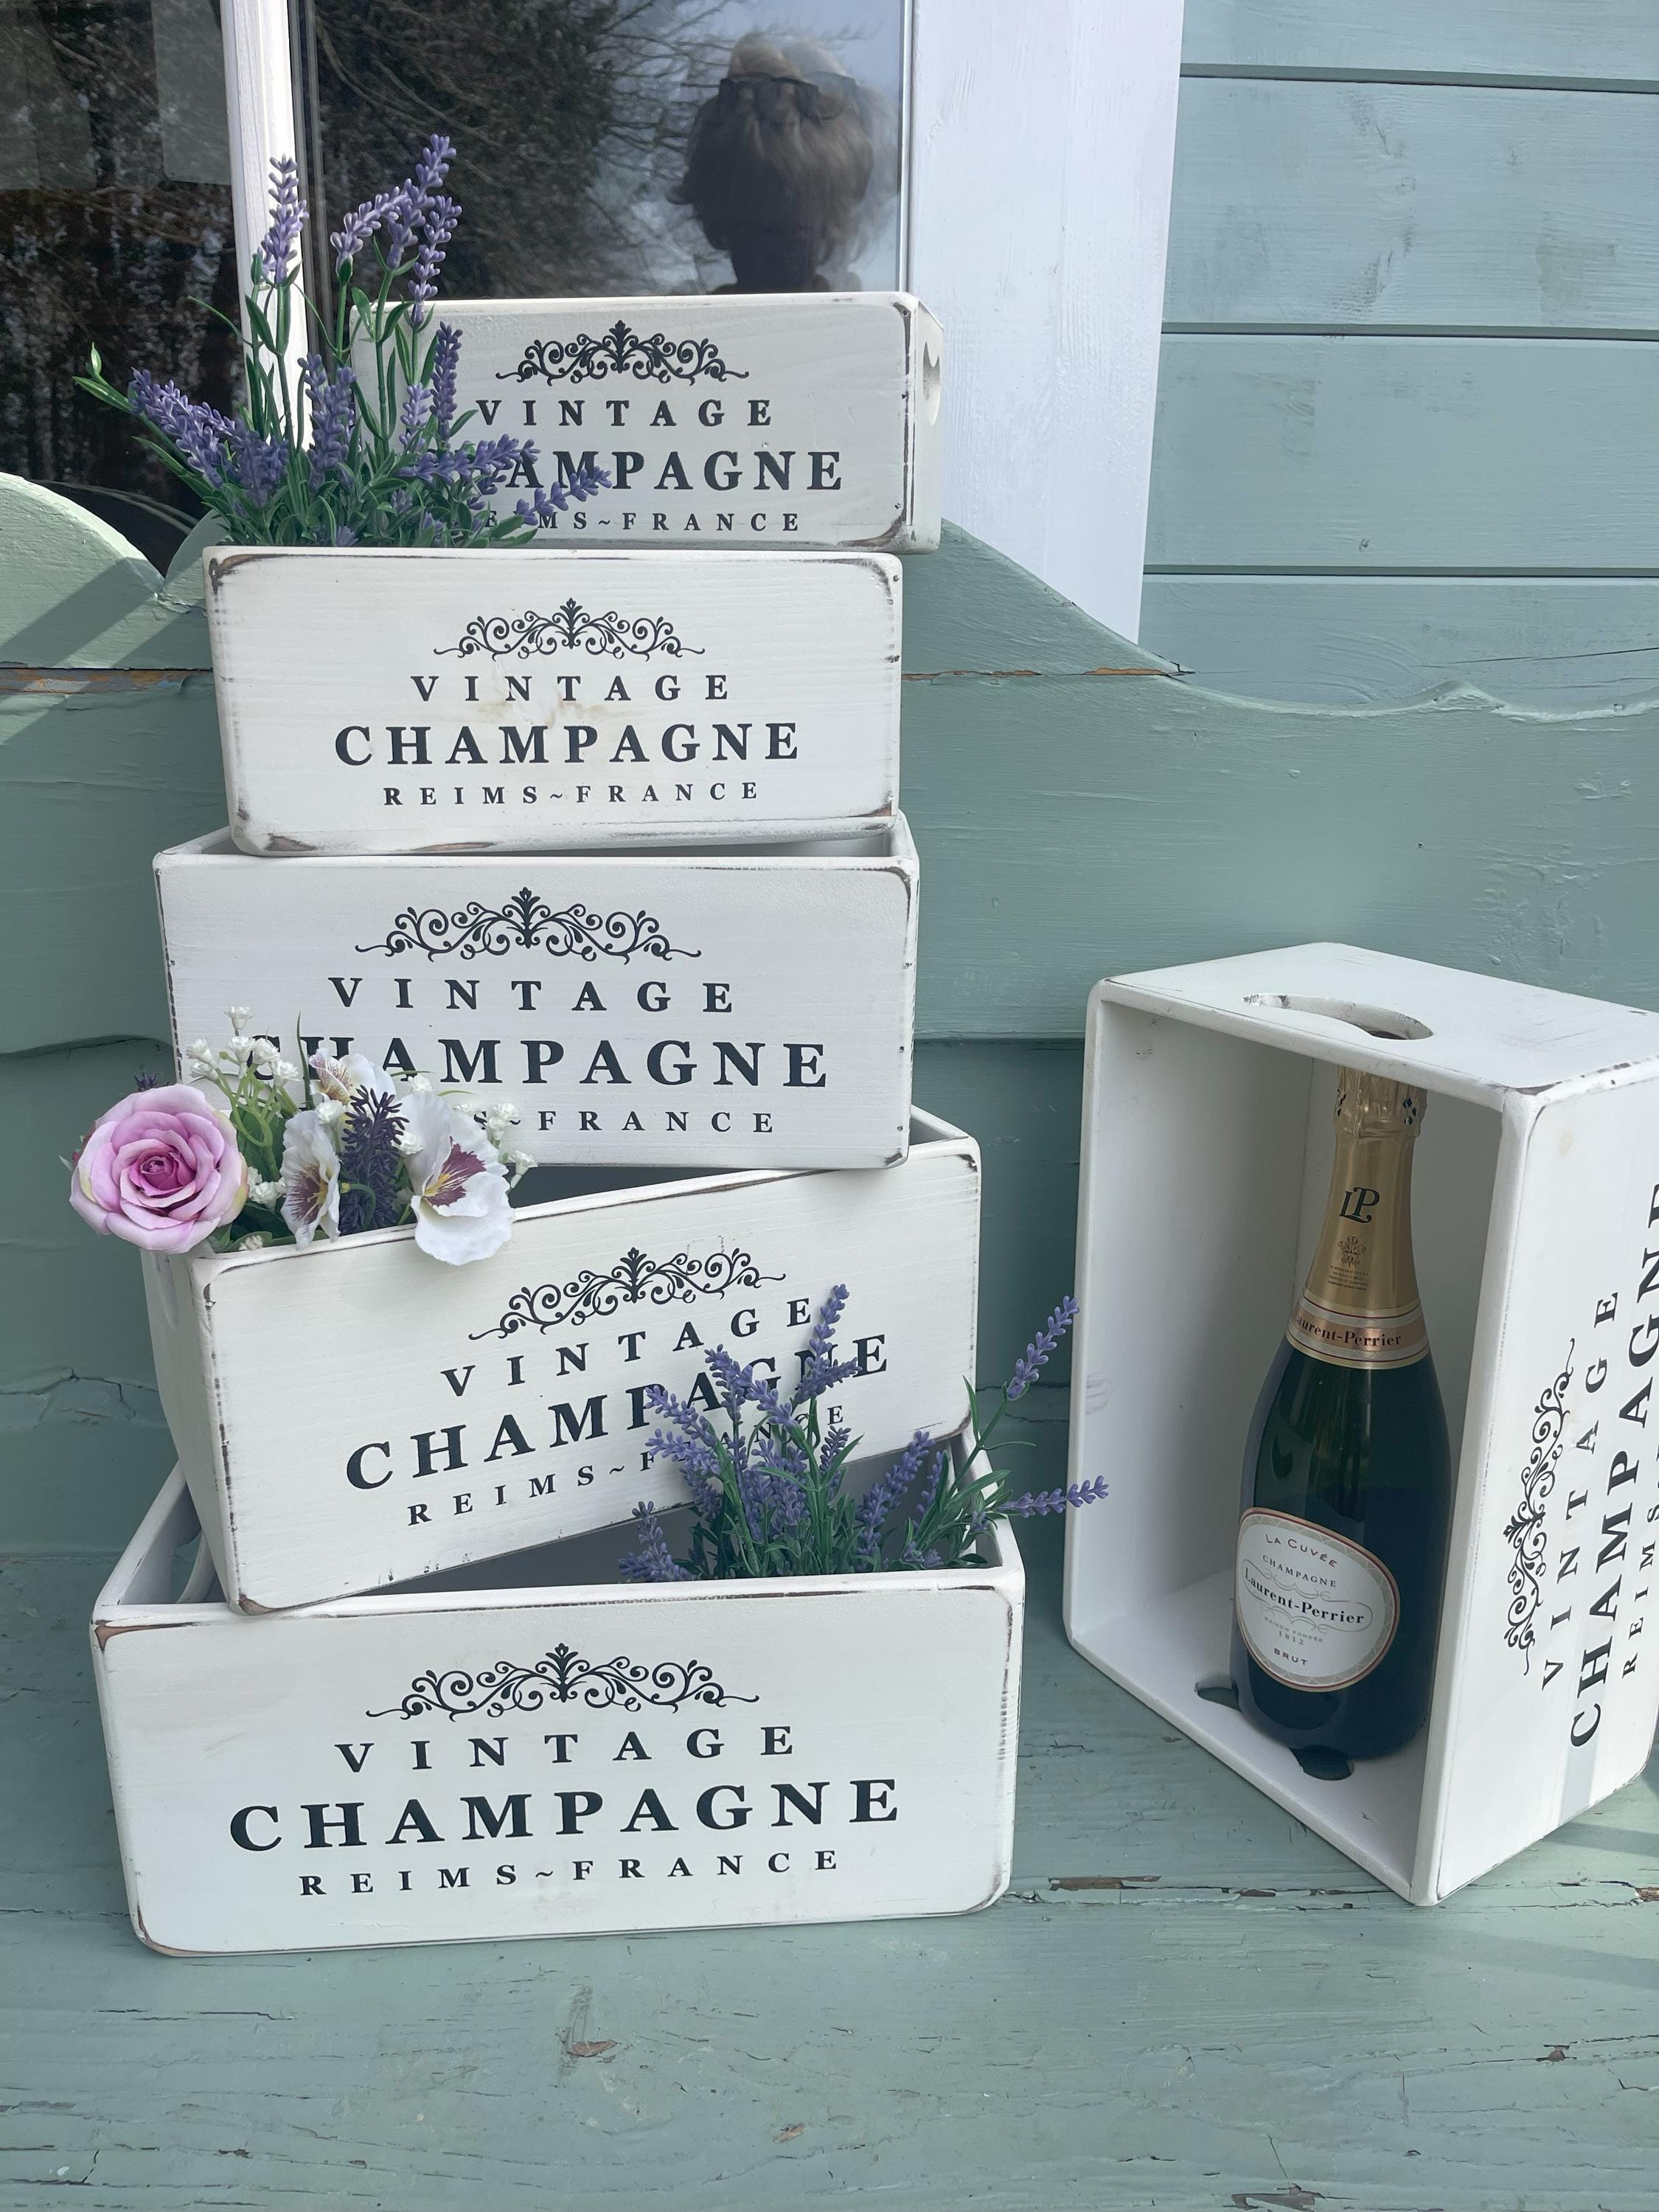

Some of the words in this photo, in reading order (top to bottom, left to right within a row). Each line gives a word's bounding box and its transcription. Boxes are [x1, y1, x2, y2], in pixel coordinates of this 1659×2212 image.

[475, 399, 771, 427] VINTAGE
[428, 448, 843, 491] AMPAGNE
[410, 675, 728, 702] VINTAGE
[335, 723, 799, 766] CHAMPAGNE
[383, 782, 757, 806] REIMS~FRANCE
[327, 977, 733, 1013] VINTAGE
[440, 1297, 812, 1398] VINTAGE
[1542, 1291, 1619, 1691] VINTAGE
[1265, 1533, 1281, 1545] LA
[1287, 1538, 1338, 1568] CUVÉE
[1262, 1554, 1337, 1588] CHAMPAGNE
[1245, 1567, 1365, 1624] Laurent-Perrier
[1273, 1647, 1308, 1666] BRUT
[1279, 1630, 1304, 1645] 1812
[334, 1725, 793, 1773] VINTAGE
[230, 1778, 898, 1852] CHAMPAGNE
[299, 1849, 837, 1896] REIMS~FRANCE
